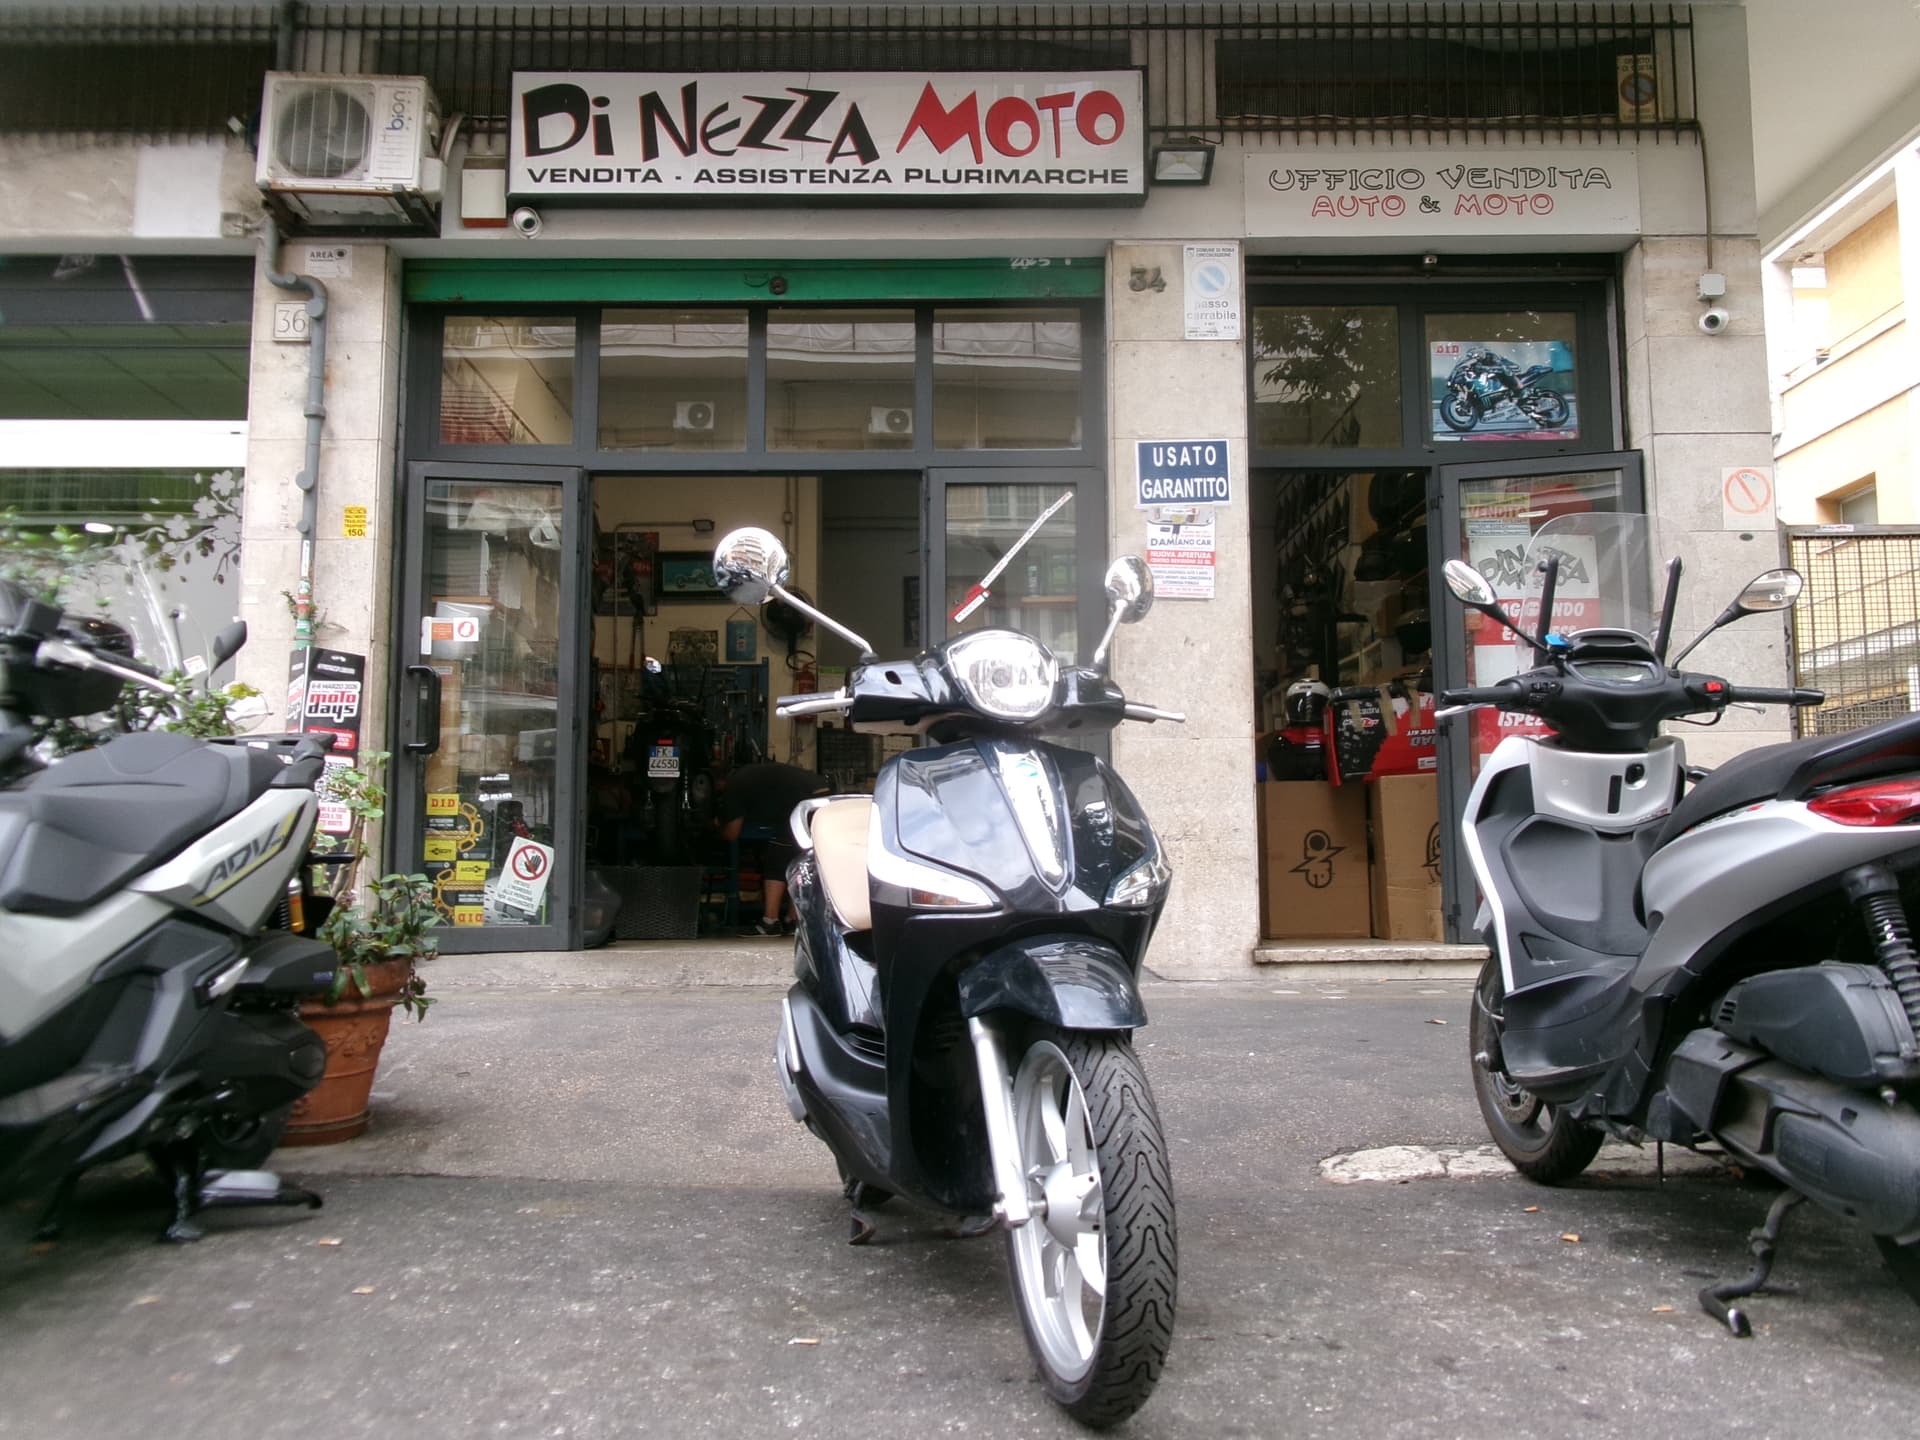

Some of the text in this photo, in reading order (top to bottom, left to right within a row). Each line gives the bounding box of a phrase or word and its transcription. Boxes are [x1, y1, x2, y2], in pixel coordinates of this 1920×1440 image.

[896, 80, 1125, 165] MOTO
[526, 167, 663, 184] VENDITA
[693, 168, 893, 185] ASSISTENZA
[904, 168, 1129, 184] PLURIMARCHE
[1269, 165, 1612, 191] UFFICIO VENDITA
[1311, 193, 1554, 217] AUTO & MOTO
[1127, 266, 1167, 293] 34
[277, 309, 306, 333] 36
[1436, 345, 1460, 353] DID
[1153, 445, 1217, 467] USATO
[1141, 477, 1228, 499] GARANTITO
[1150, 538, 1195, 546] DAMIANO
[310, 690, 356, 703] moto
[308, 702, 355, 719] days
[431, 799, 456, 807] DID
